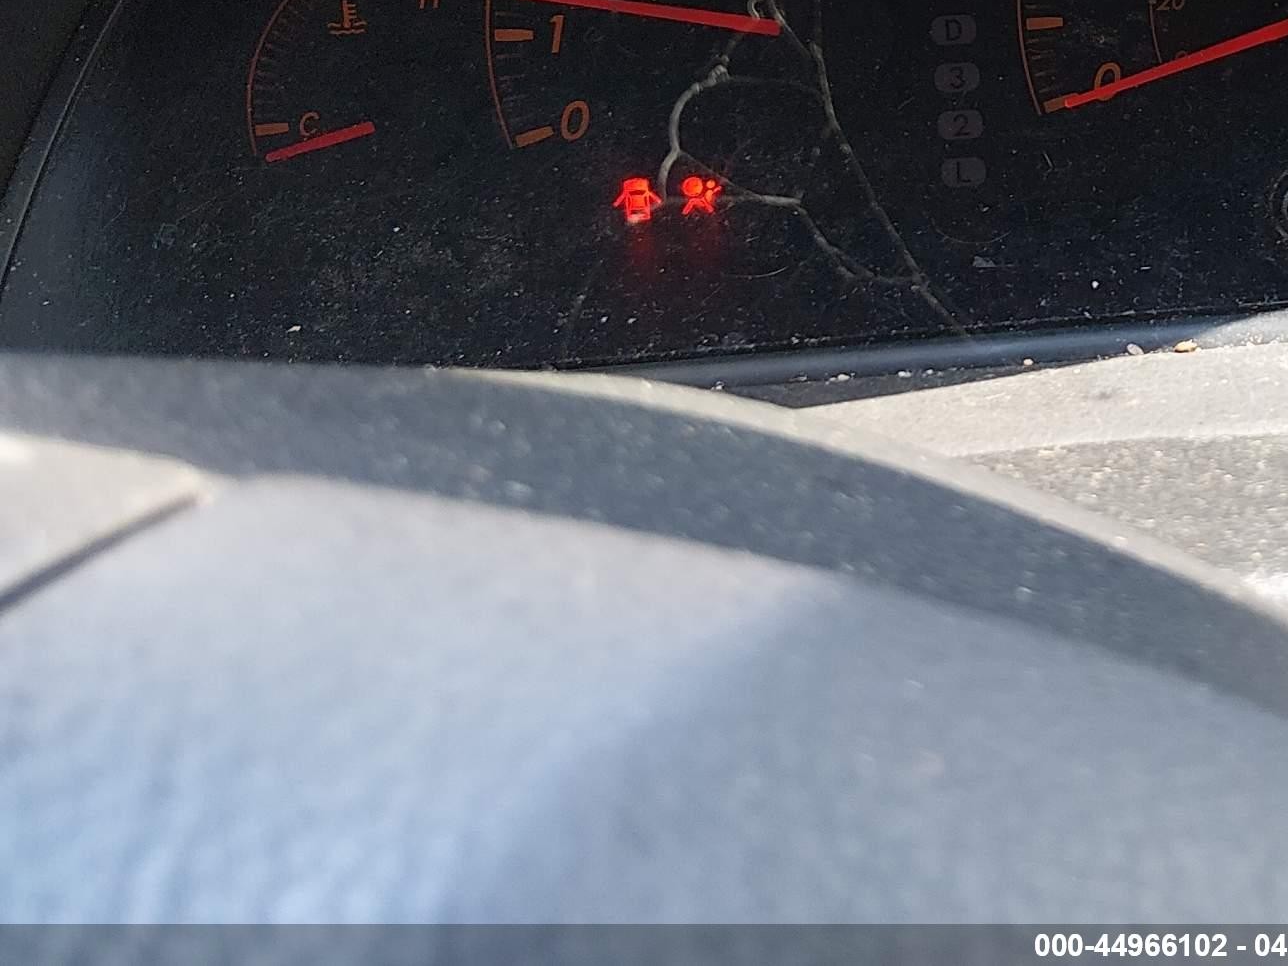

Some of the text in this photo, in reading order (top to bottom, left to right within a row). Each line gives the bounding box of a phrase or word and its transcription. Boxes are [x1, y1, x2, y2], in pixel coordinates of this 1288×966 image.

[548, 16, 564, 54] 1
[945, 19, 961, 41] D
[949, 66, 966, 88] 3
[1093, 62, 1123, 100] 0
[299, 111, 320, 135] C
[560, 101, 590, 140] 0
[951, 114, 970, 136] 2
[954, 161, 972, 183] L
